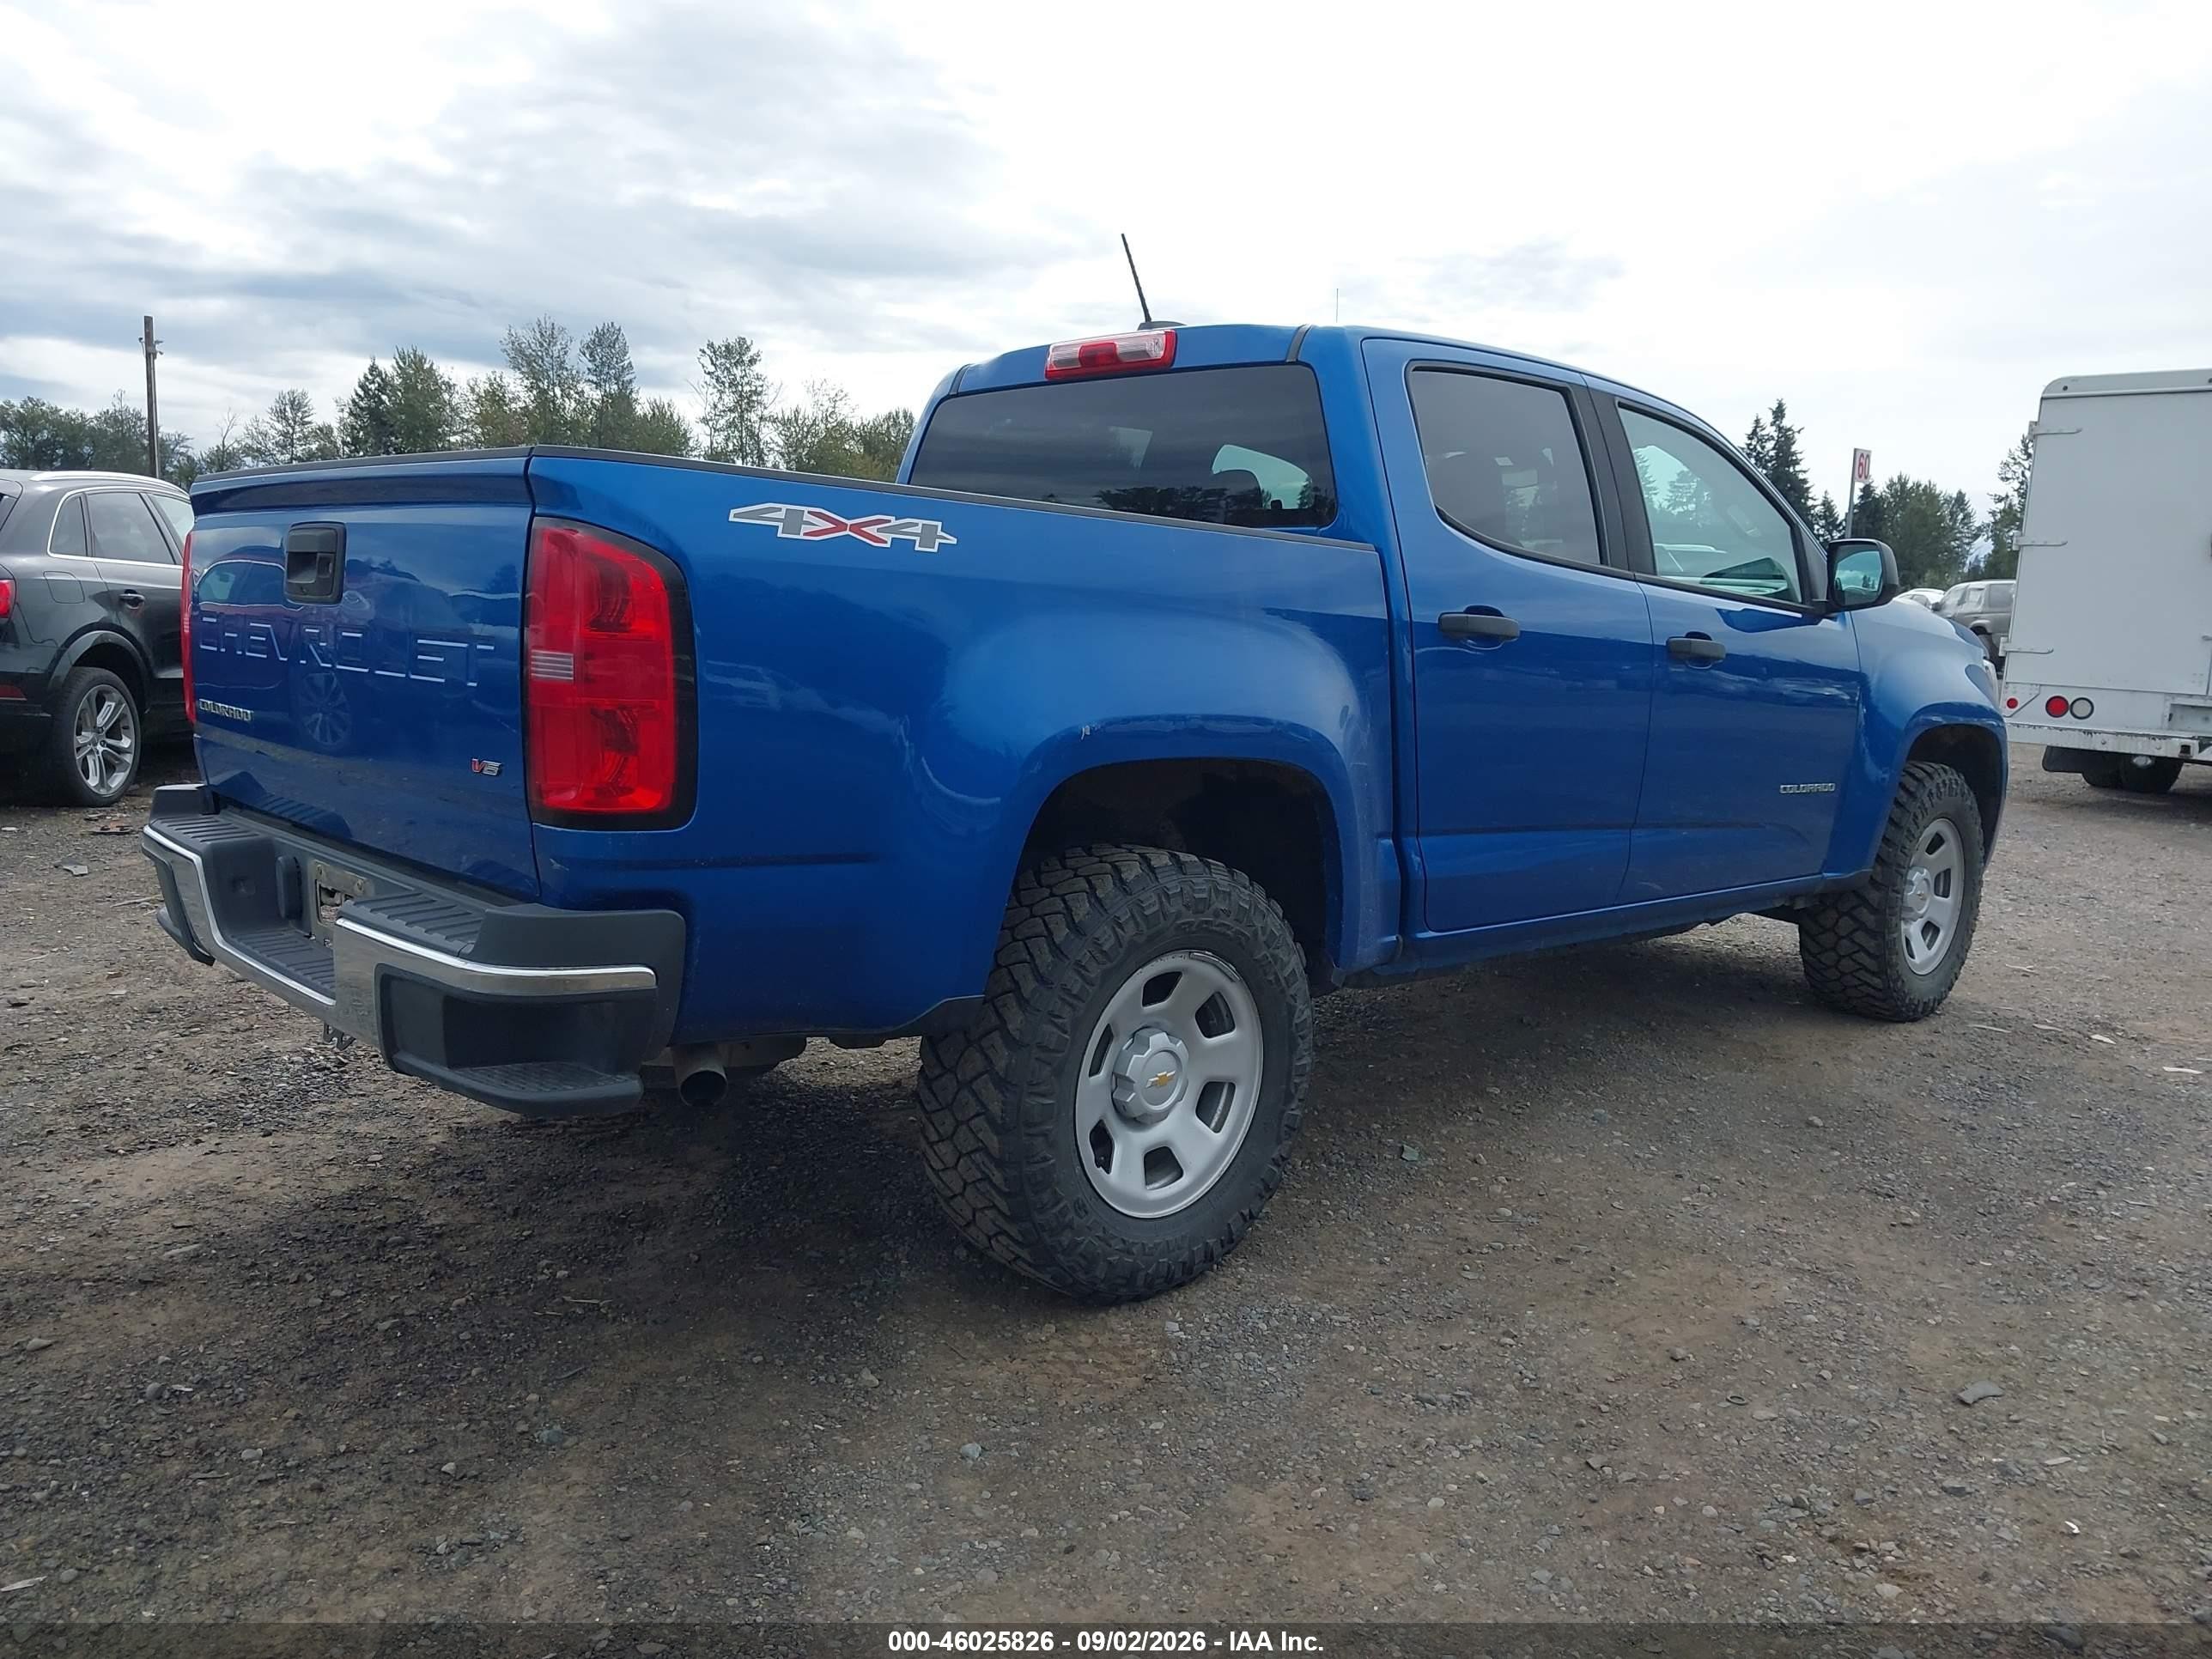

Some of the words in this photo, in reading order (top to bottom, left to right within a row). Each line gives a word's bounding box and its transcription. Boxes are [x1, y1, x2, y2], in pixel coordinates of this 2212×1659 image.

[1858, 453, 1870, 479] 60
[198, 612, 495, 688] CHEVROLET
[199, 698, 254, 721] COLORADO
[471, 758, 502, 776] V6
[1779, 782, 1836, 794] COLORADO
